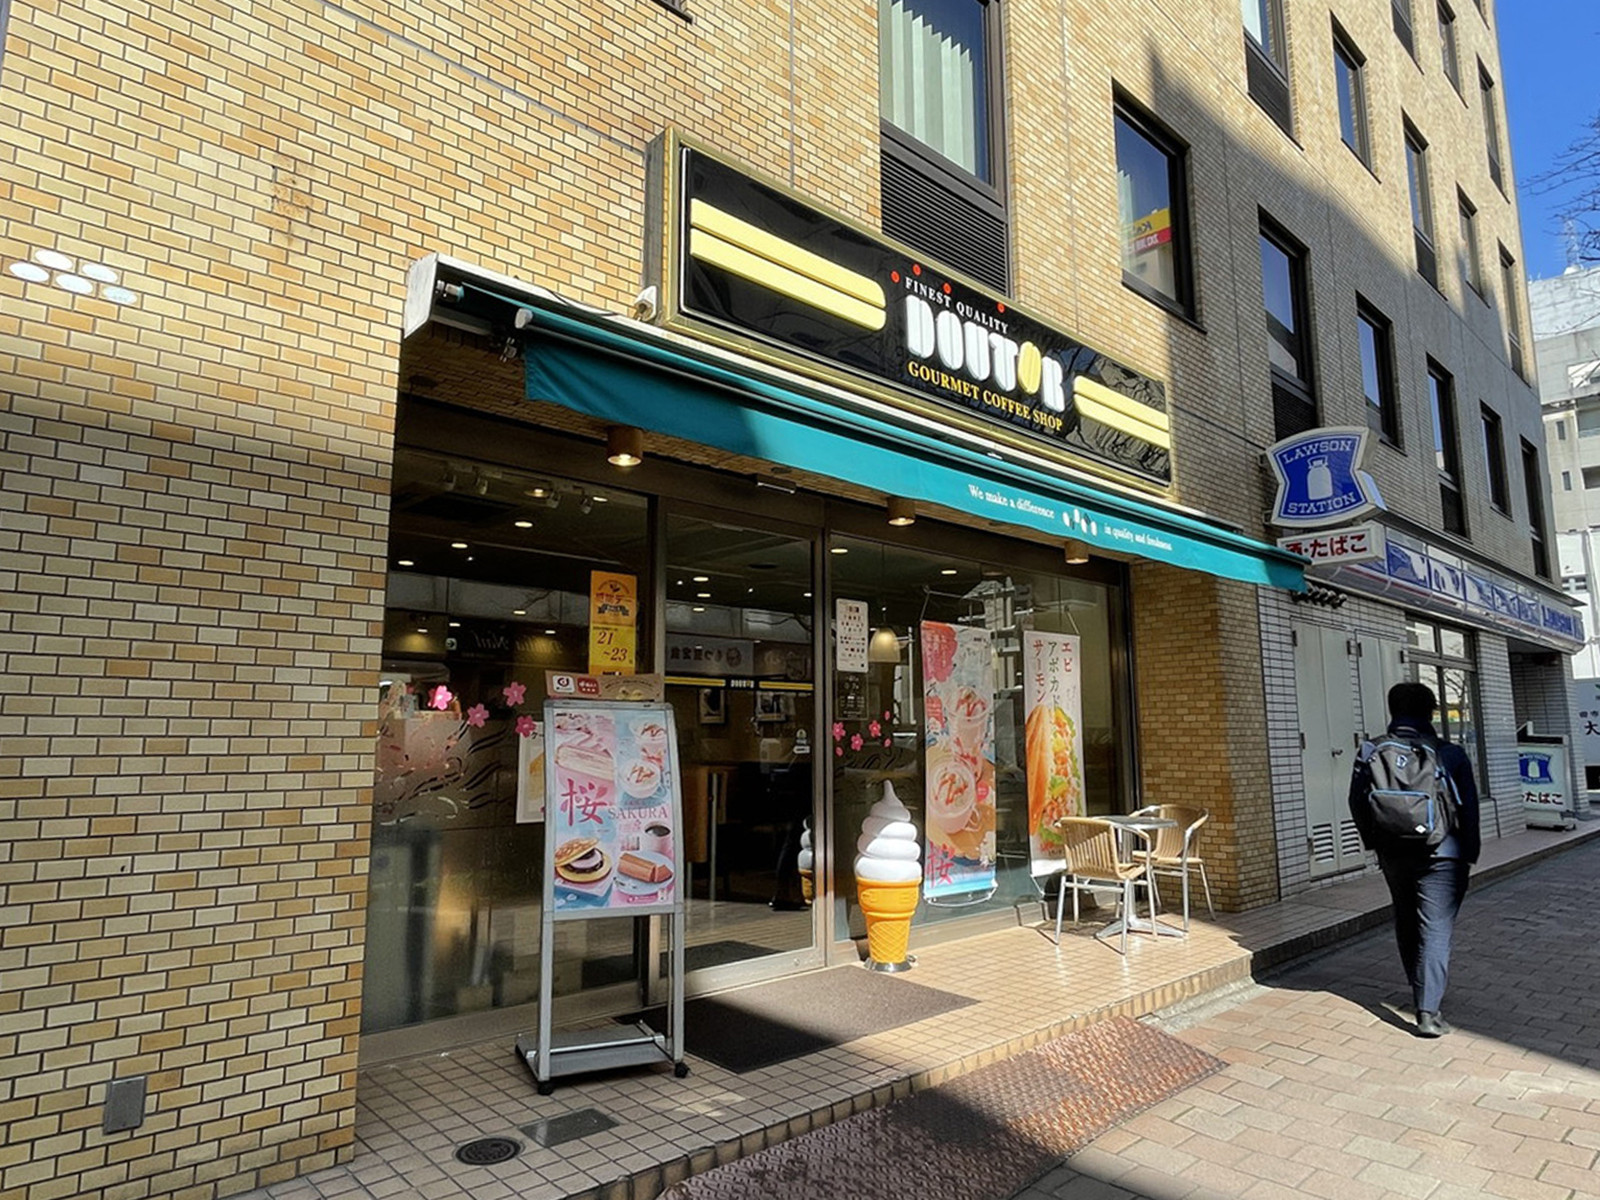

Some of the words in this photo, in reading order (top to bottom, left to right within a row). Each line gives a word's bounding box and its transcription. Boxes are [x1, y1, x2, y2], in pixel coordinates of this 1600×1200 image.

[905, 277, 951, 307] FINEST
[956, 301, 1009, 334] QUALITY
[906, 294, 1065, 413] DOUTOR
[908, 360, 980, 399] GOURMET
[983, 389, 1031, 420] COFFEE
[1033, 407, 1063, 431] SHOP
[1283, 440, 1352, 464] LAWSON
[968, 484, 984, 500] We
[985, 492, 1008, 506] make
[1287, 491, 1356, 514] STATION
[597, 631, 613, 645] 21
[1033, 640, 1046, 702] サーモン
[561, 778, 607, 826] 桜
[607, 804, 668, 820] SAKURA
[926, 841, 955, 889] 桜
